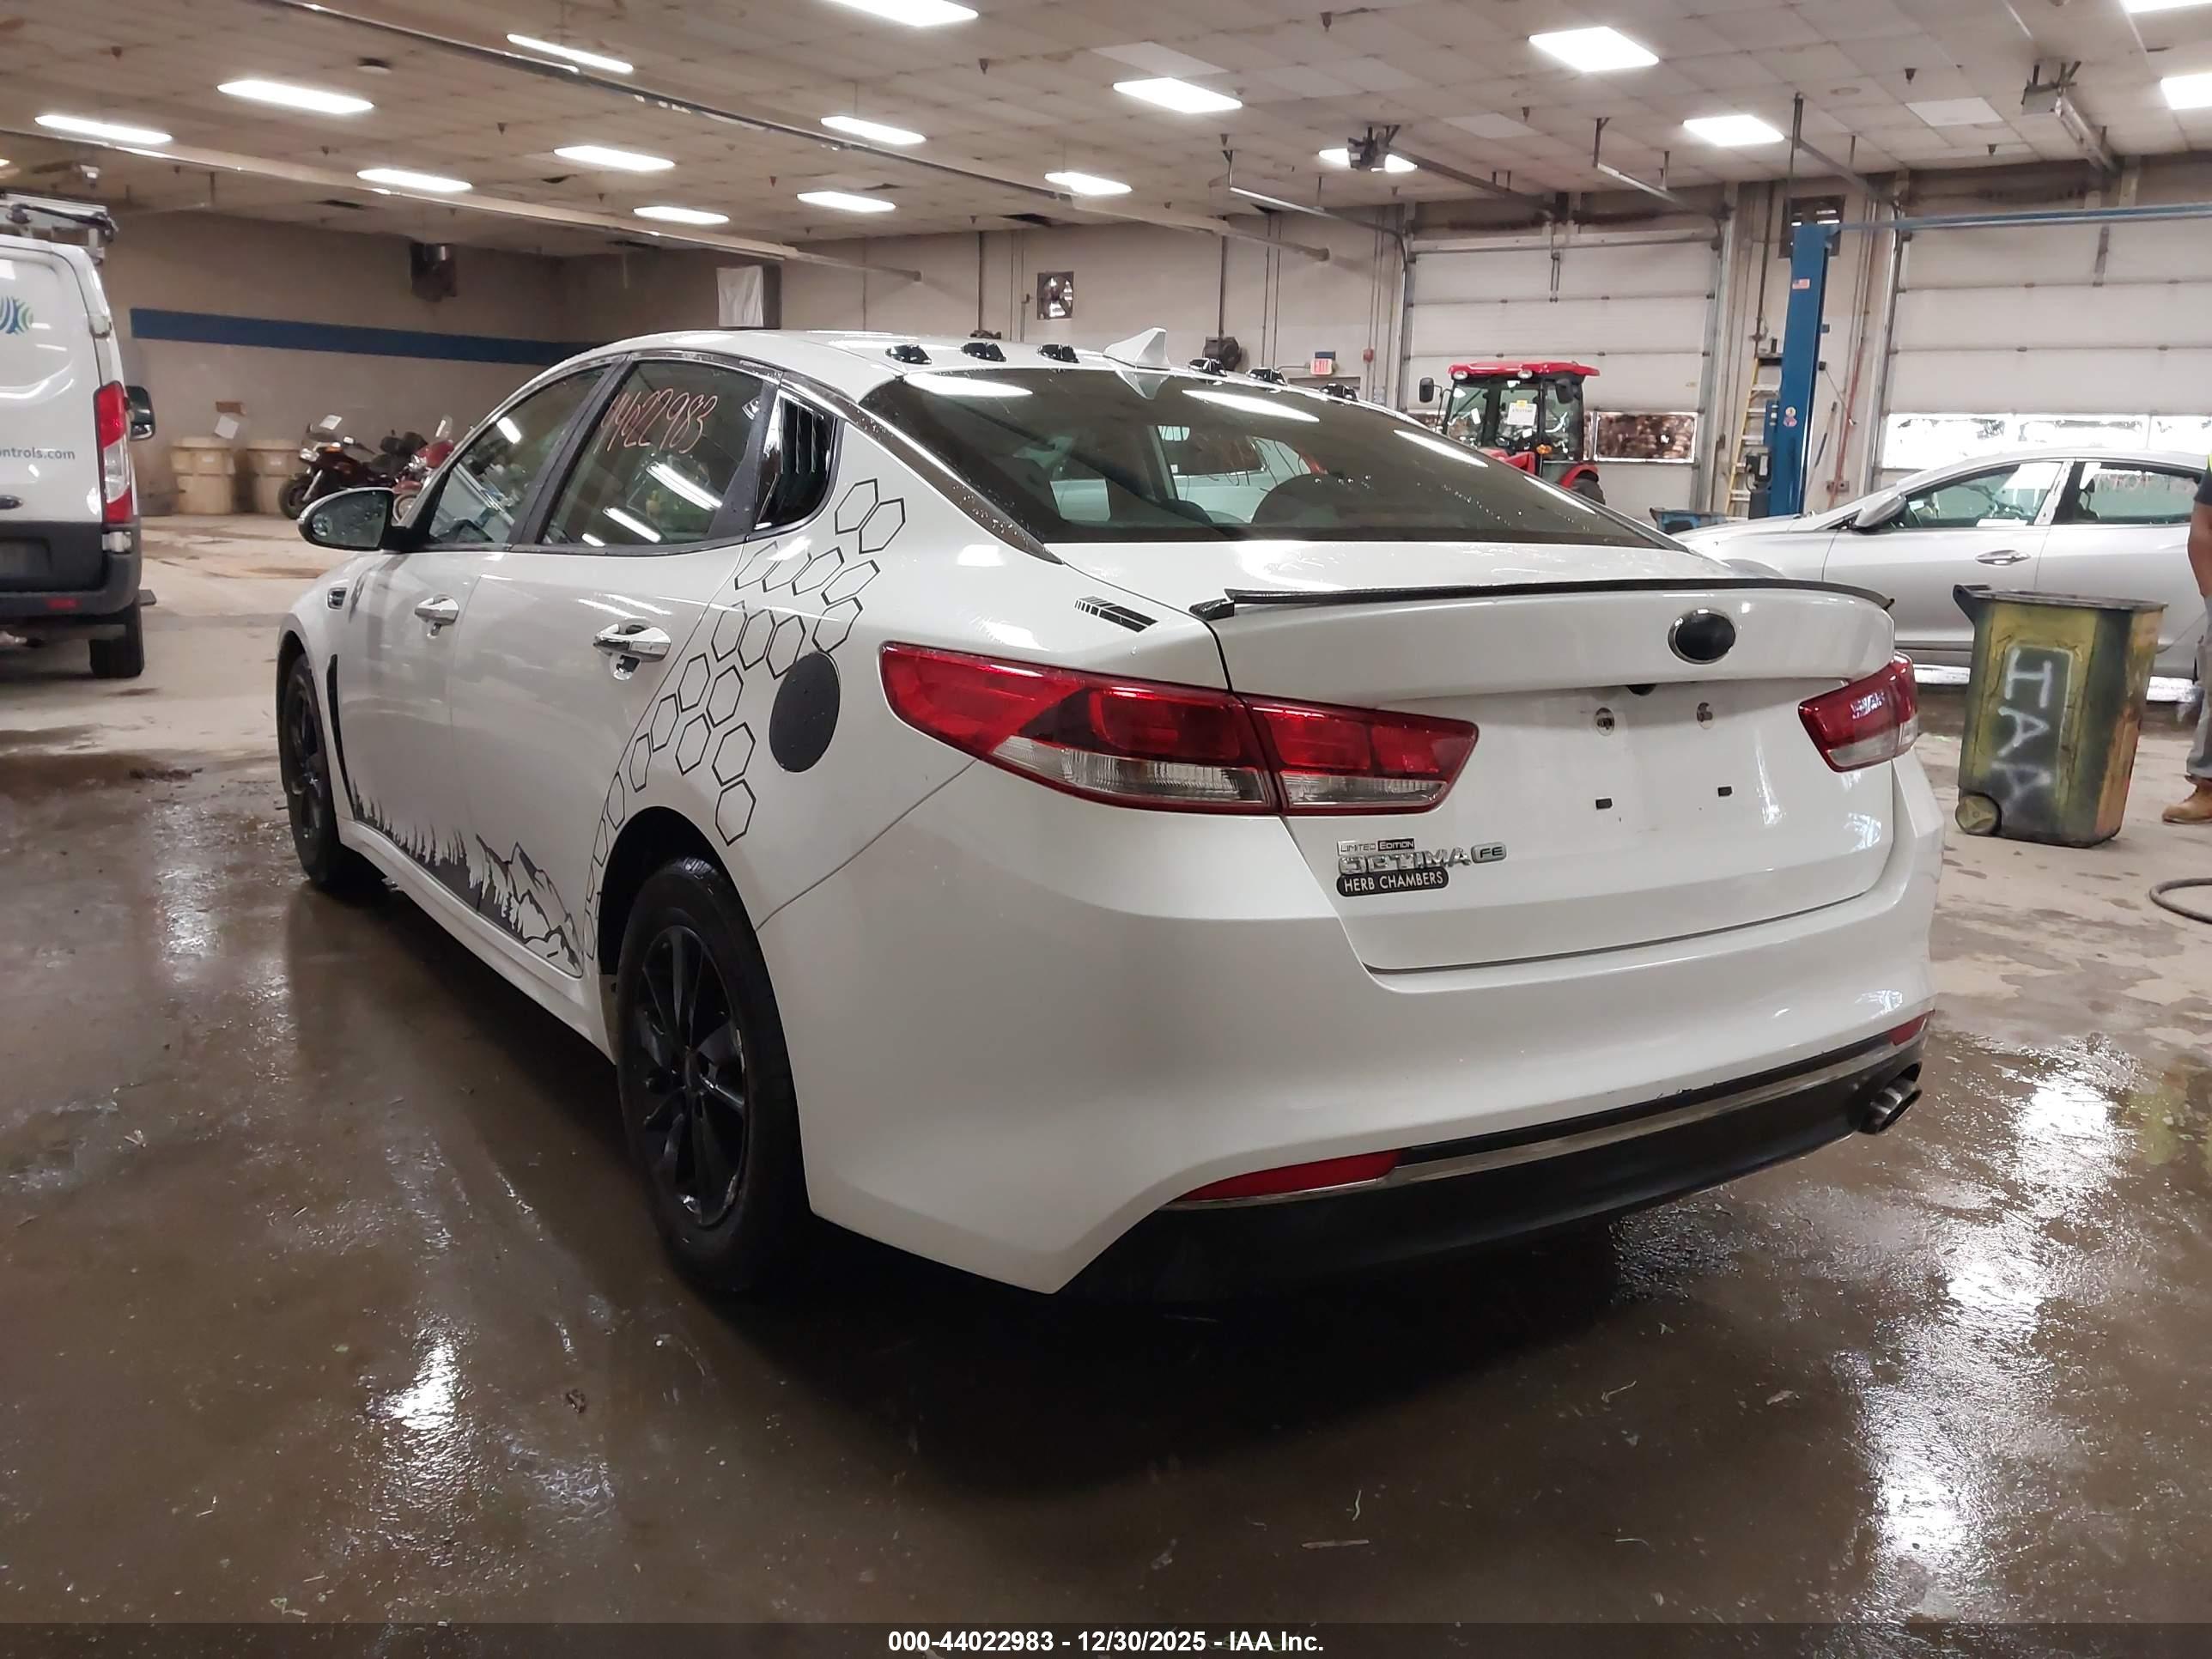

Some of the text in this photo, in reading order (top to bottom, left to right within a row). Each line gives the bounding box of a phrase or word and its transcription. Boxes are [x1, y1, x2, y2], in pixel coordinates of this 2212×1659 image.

[592, 388, 718, 454] 44022983
[0, 447, 76, 459] ntrols.com
[1339, 846, 1503, 874] OPTIMA FE
[1343, 871, 1443, 893] HERB CHAMBERS
